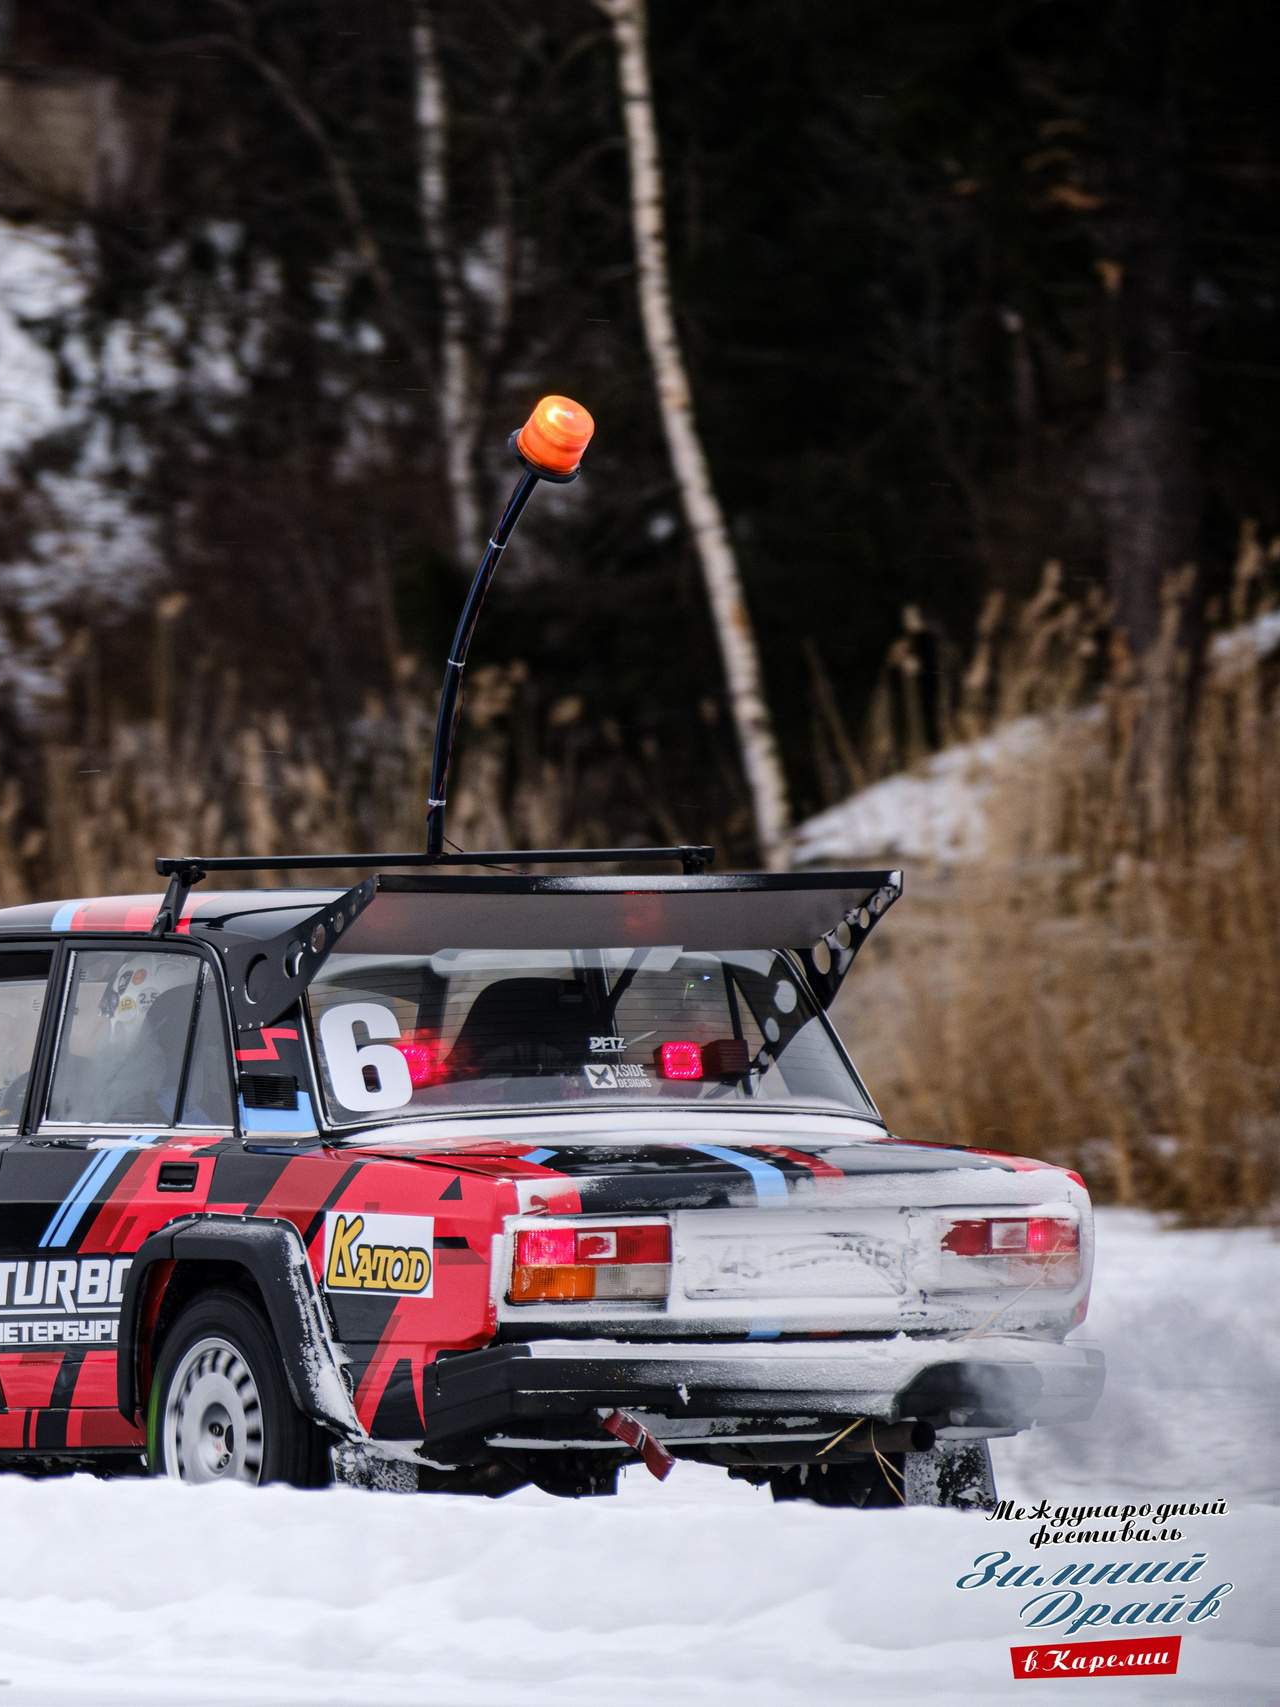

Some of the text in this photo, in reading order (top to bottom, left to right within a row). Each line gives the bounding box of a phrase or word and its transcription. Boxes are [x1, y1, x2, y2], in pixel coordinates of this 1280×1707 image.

[319, 1002, 413, 1112] 6
[612, 1064, 647, 1077] XSIDE
[617, 1079, 652, 1088] DESIGNS
